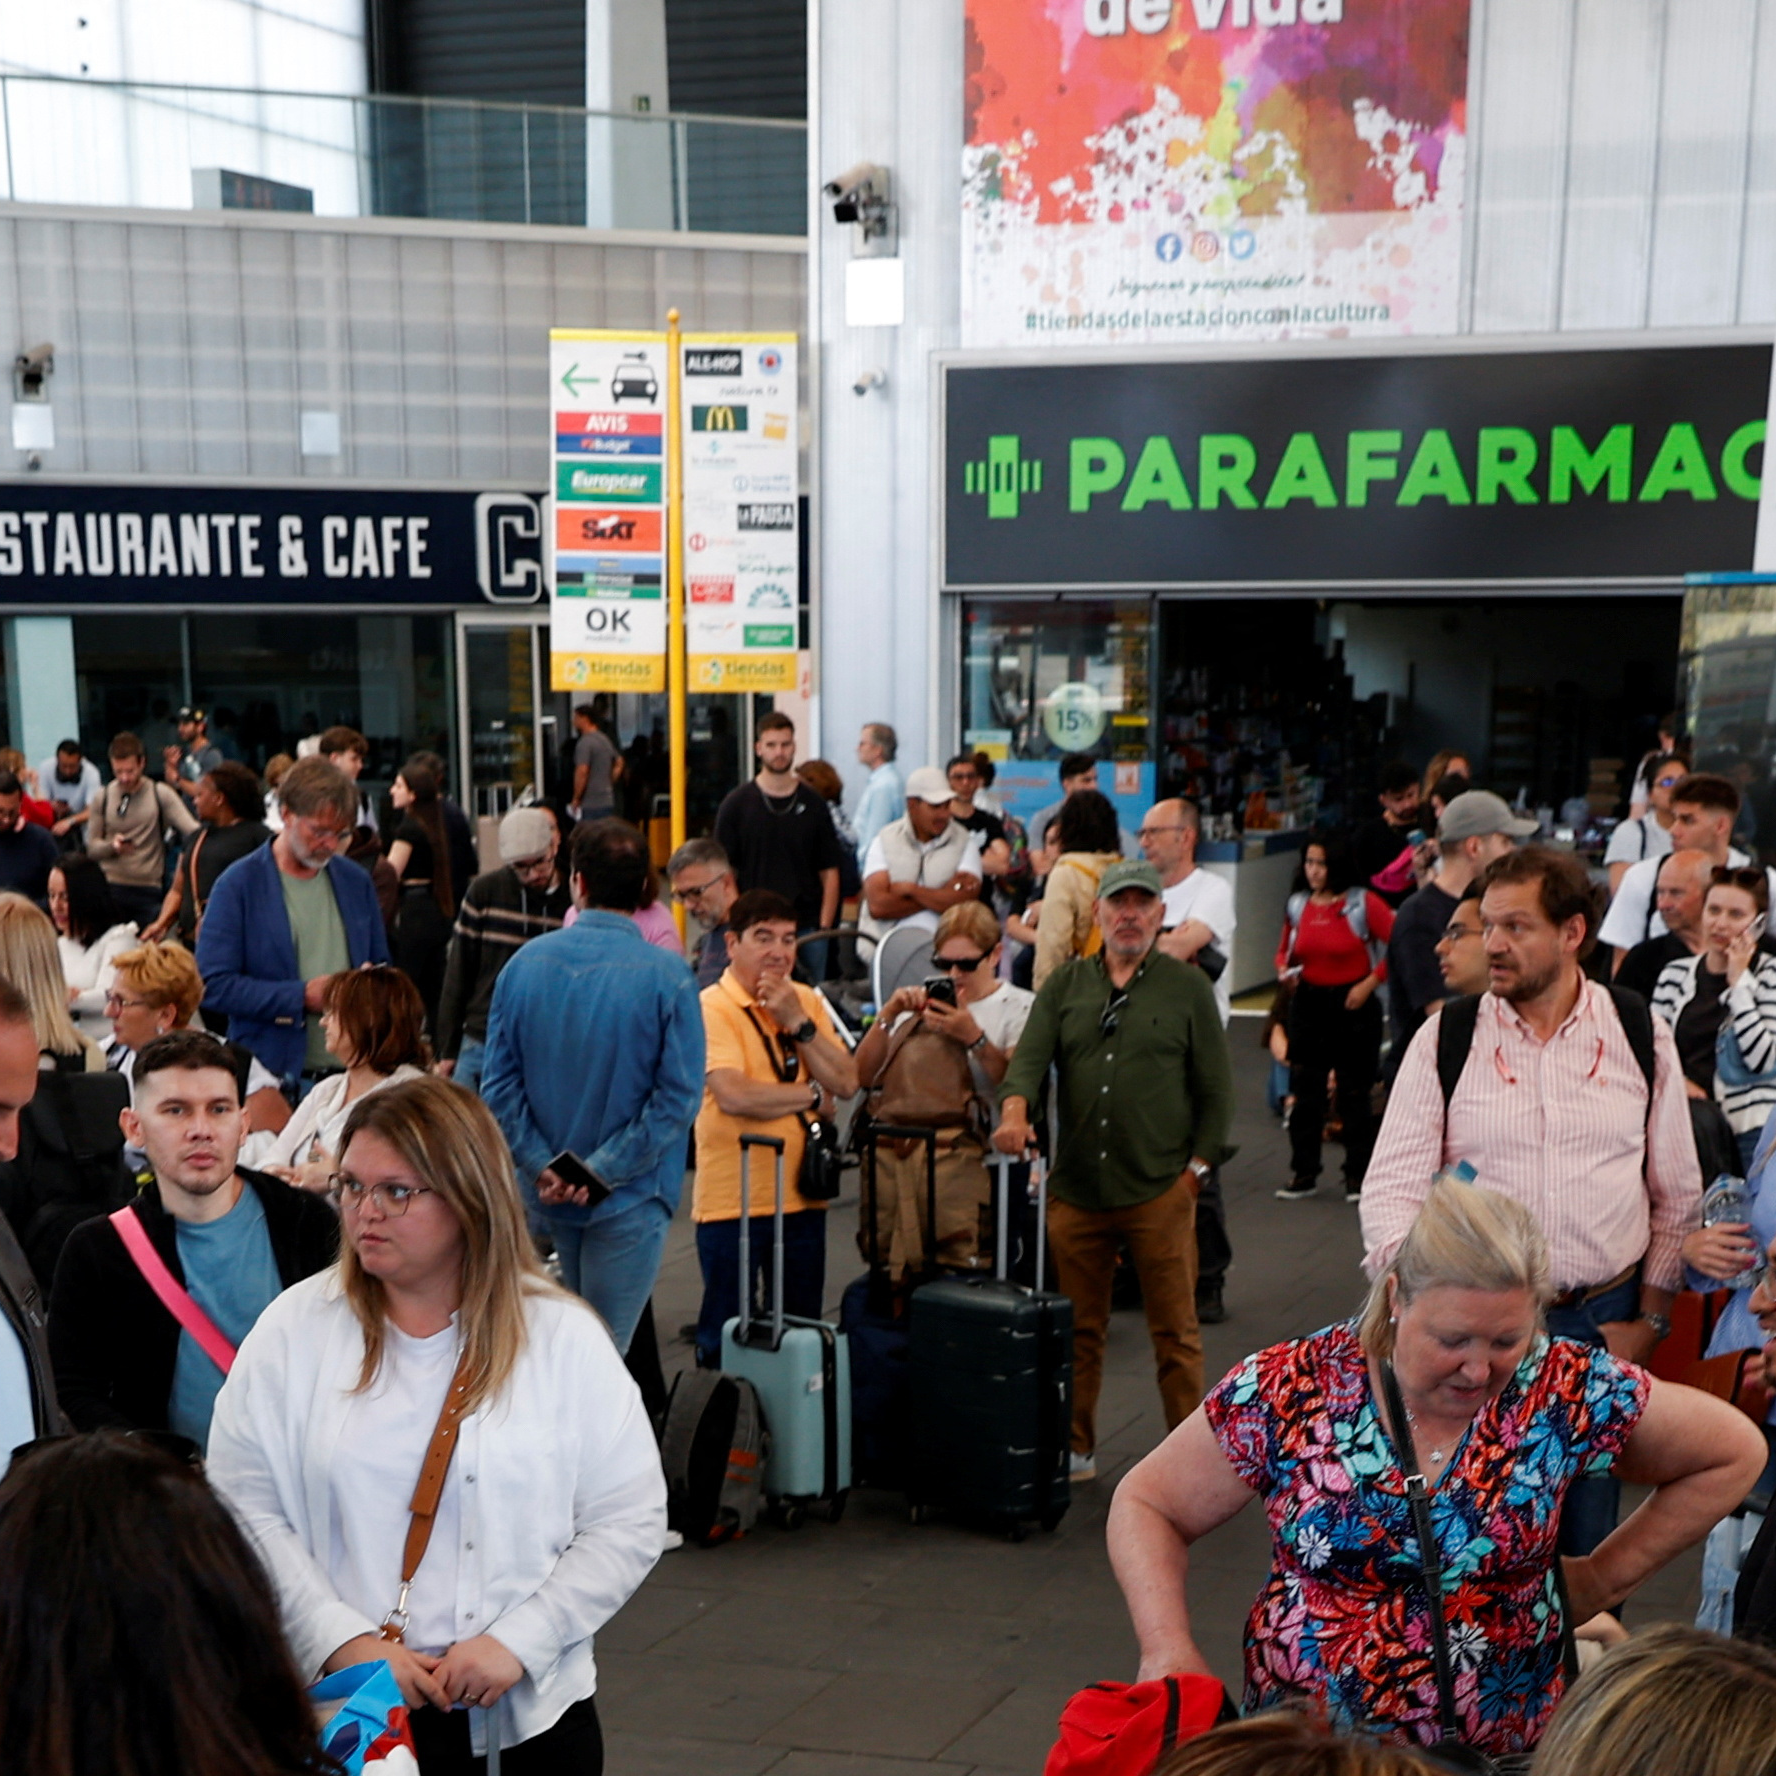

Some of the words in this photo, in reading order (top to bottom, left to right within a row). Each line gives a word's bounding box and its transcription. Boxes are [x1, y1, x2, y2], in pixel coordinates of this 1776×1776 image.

[586, 413, 629, 433] AVIS
[571, 470, 647, 493] Europcar
[278, 515, 307, 578] &
[323, 516, 432, 579] CAFE
[586, 608, 631, 632] OK
[591, 660, 651, 676] tiendas
[726, 661, 786, 675] tiendas
